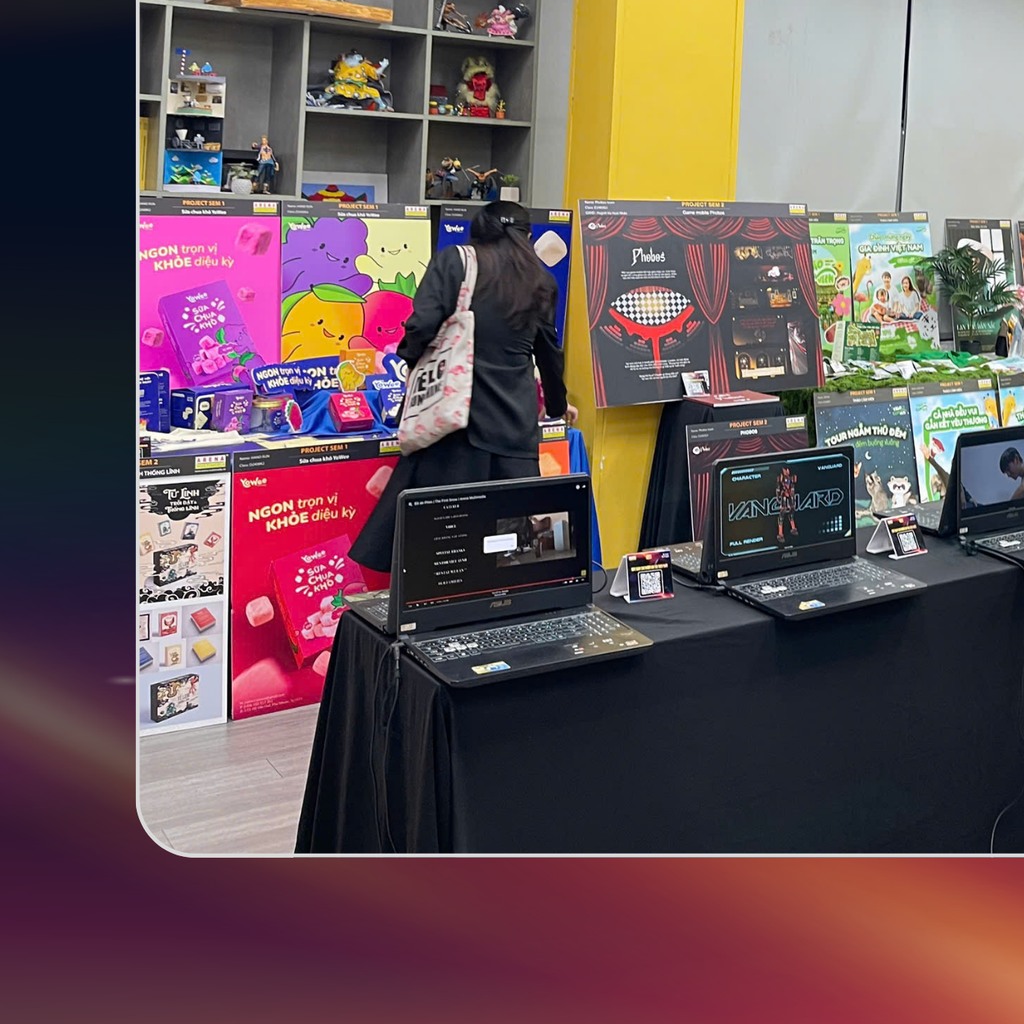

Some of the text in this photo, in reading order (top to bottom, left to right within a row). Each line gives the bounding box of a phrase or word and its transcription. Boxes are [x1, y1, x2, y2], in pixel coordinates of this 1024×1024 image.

[182, 199, 207, 207] PROJECT
[906, 243, 924, 252] NAM
[139, 245, 178, 262] NGON
[181, 244, 205, 256] trọn
[729, 420, 750, 428] PROJECT
[824, 431, 848, 448] TOUR
[300, 445, 329, 454] PROJECT
[329, 444, 344, 452] SEM
[817, 462, 843, 471] VANGUARD
[731, 473, 762, 482] CHARACTER
[248, 492, 338, 523] NGON trọn vị
[265, 506, 356, 532] KHỎE diệu kỳ
[743, 537, 763, 545] RENDER
[308, 571, 335, 585] CHUA
